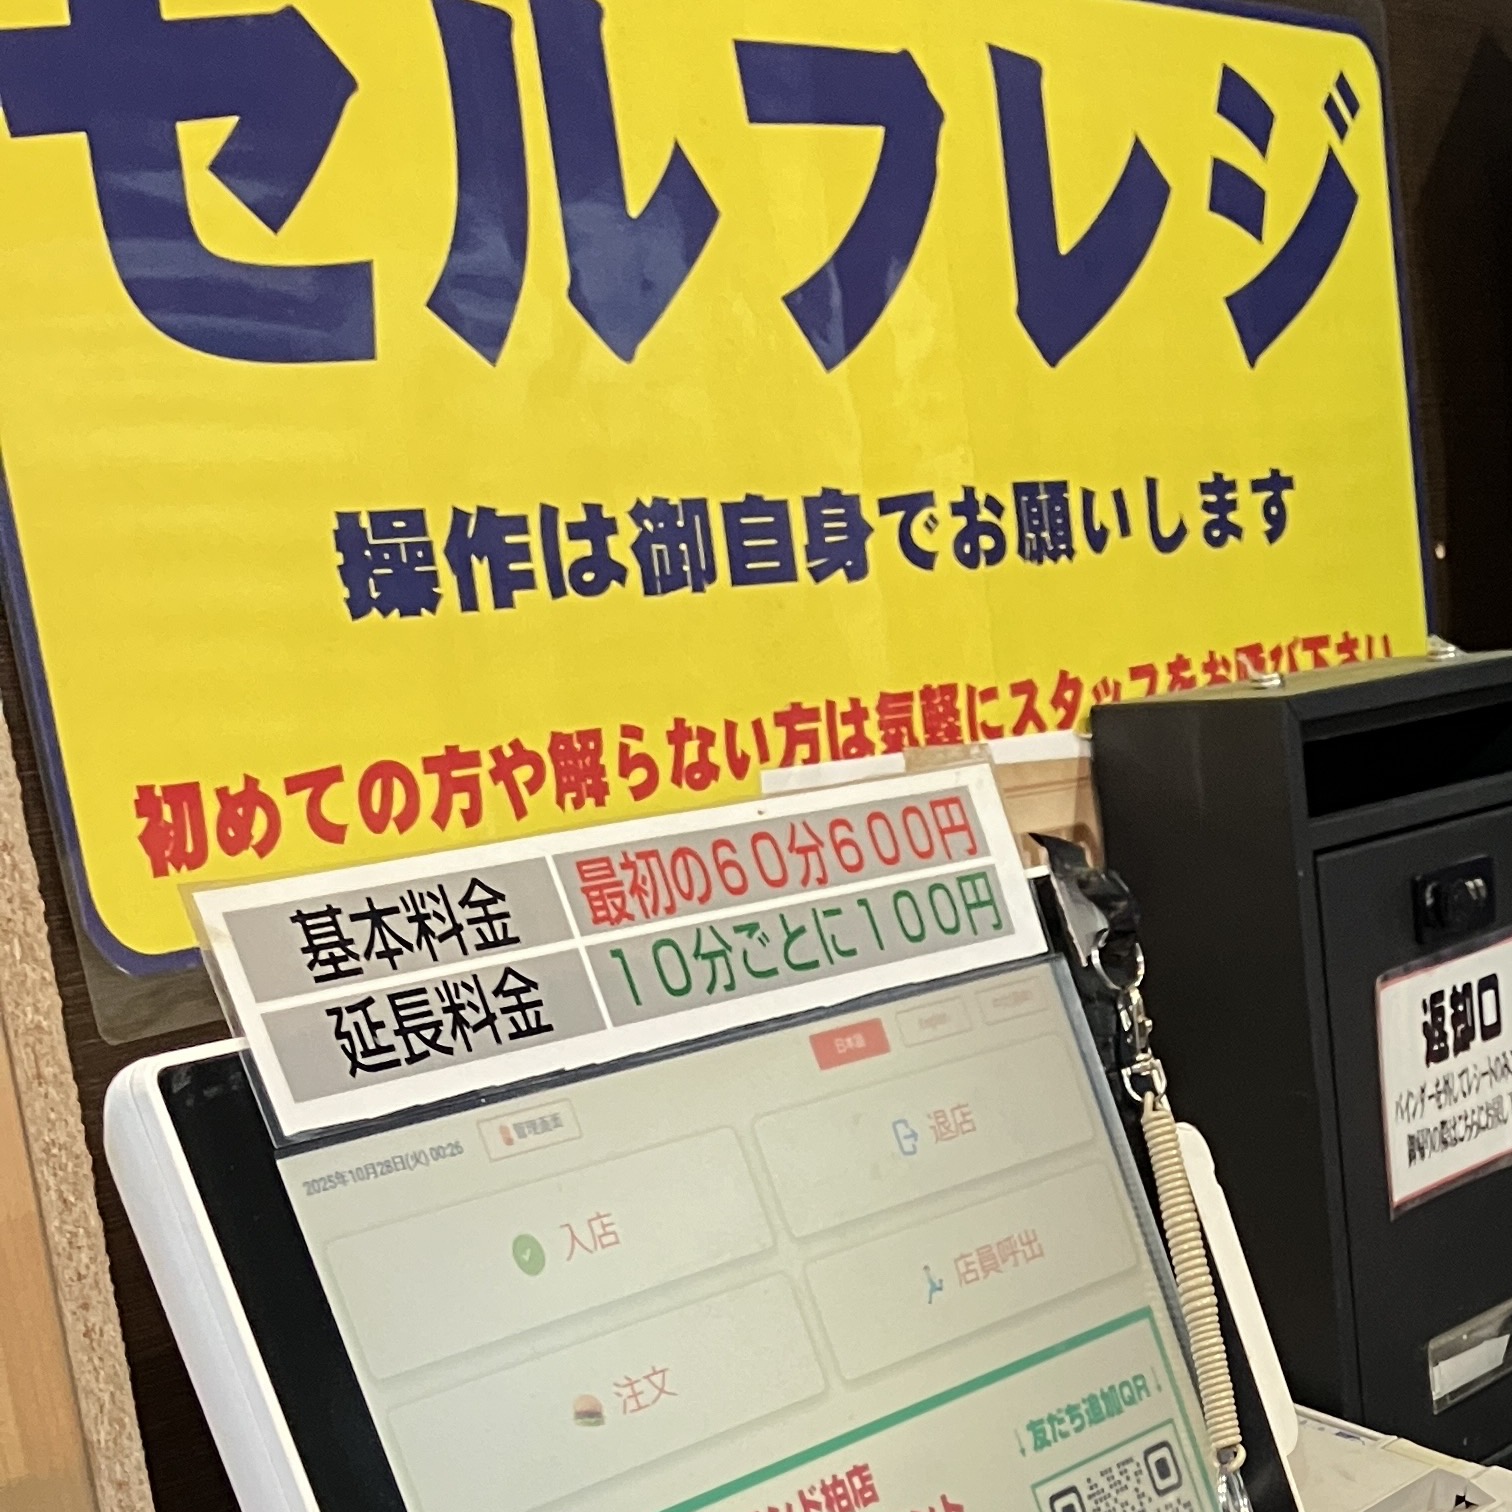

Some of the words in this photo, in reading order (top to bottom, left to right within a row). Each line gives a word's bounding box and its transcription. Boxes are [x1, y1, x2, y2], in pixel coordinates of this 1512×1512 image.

[0, 0, 1360, 373] セルフレジ
[334, 469, 1295, 621] 操作は御自身でお願いします
[291, 877, 522, 987] 基本料金
[574, 796, 981, 925] 最初の60分600円
[327, 966, 554, 1079] 延長料金
[608, 871, 1004, 1007] 10分ごとに100円
[928, 1103, 978, 1145] 退店
[559, 1211, 621, 1261] 入店
[952, 1228, 1045, 1288] 店員呼出
[612, 1365, 679, 1416] 注文
